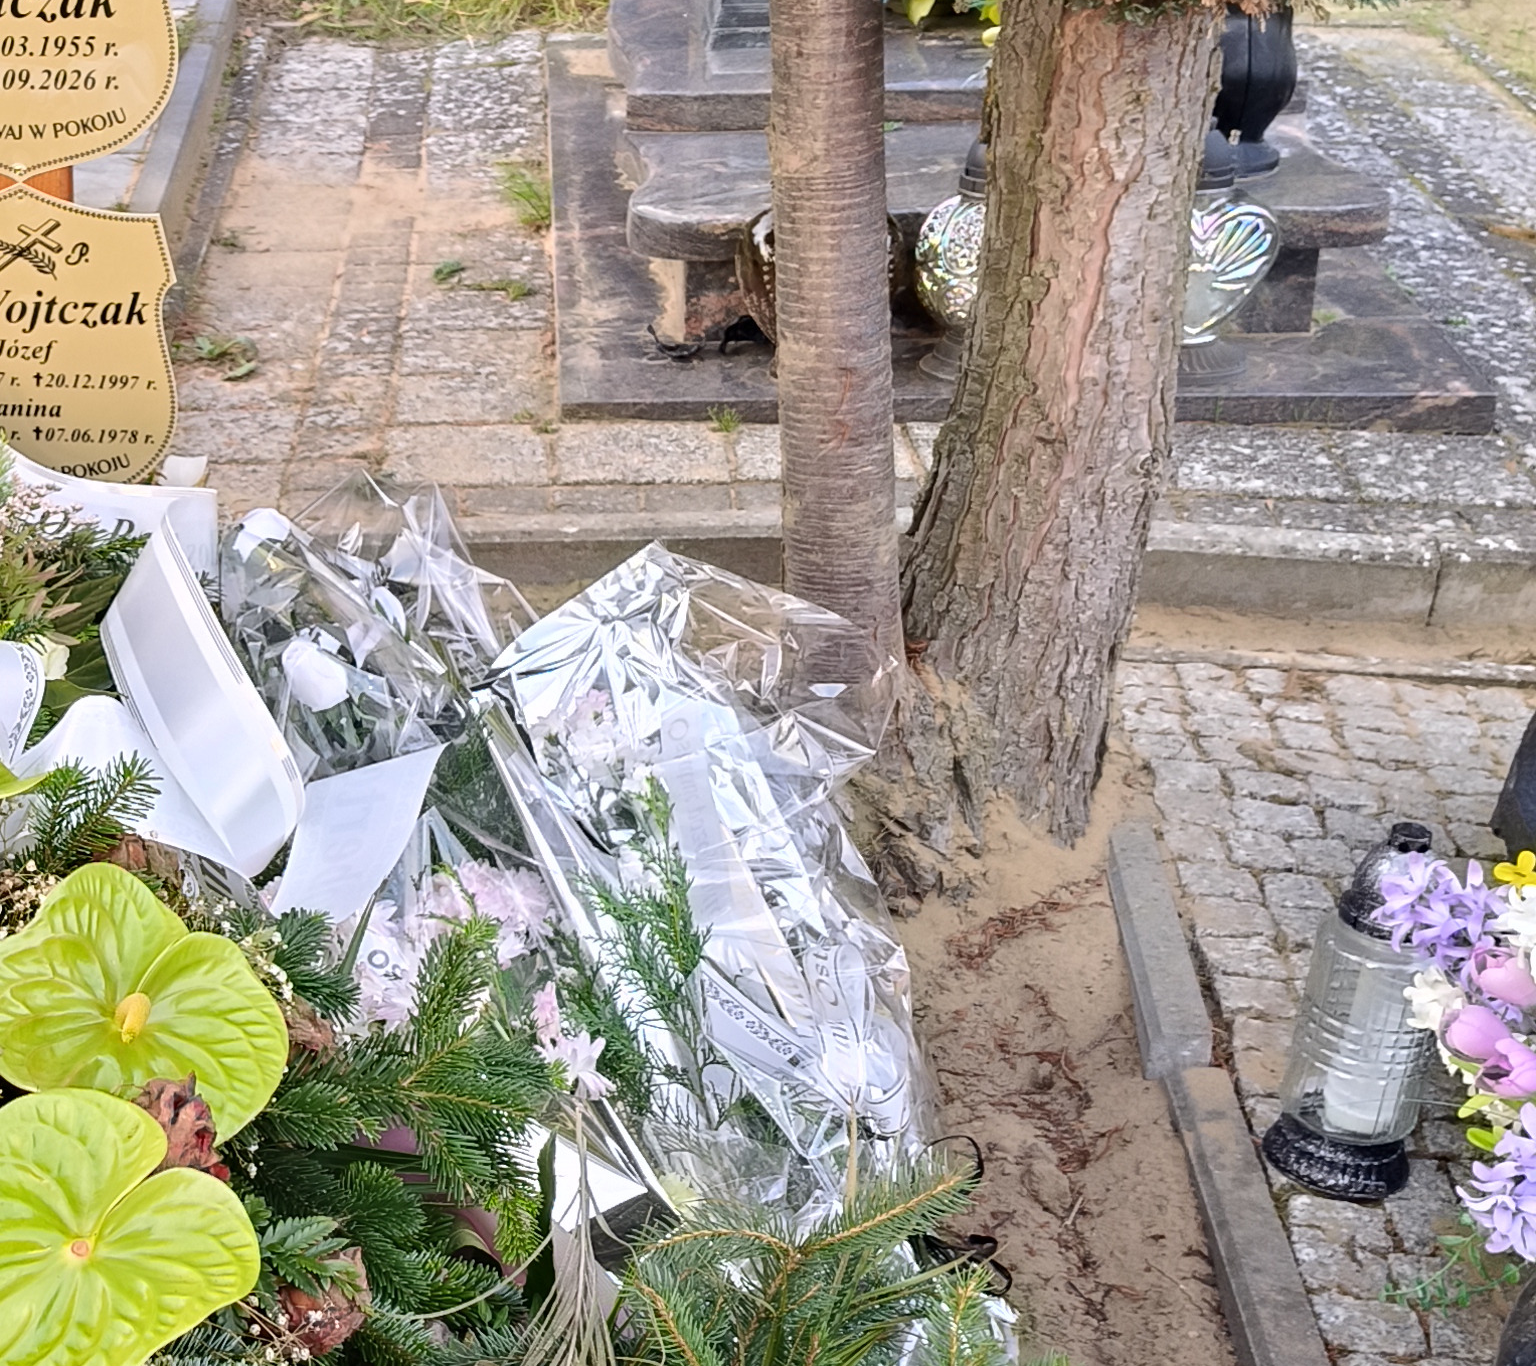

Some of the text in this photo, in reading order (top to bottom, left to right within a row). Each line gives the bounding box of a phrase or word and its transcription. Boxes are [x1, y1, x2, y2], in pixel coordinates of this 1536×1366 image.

[103, 42, 119, 57] r.
[104, 75, 120, 90] r.
[27, 123, 47, 140] W
[52, 107, 127, 138] POKOJU
[9, 376, 22, 387] r.
[44, 372, 140, 391] 20.12.1997
[146, 379, 159, 391] r.
[44, 427, 139, 445] 07.06.1978
[143, 434, 156, 445] r.
[64, 453, 132, 479] POKOJU
